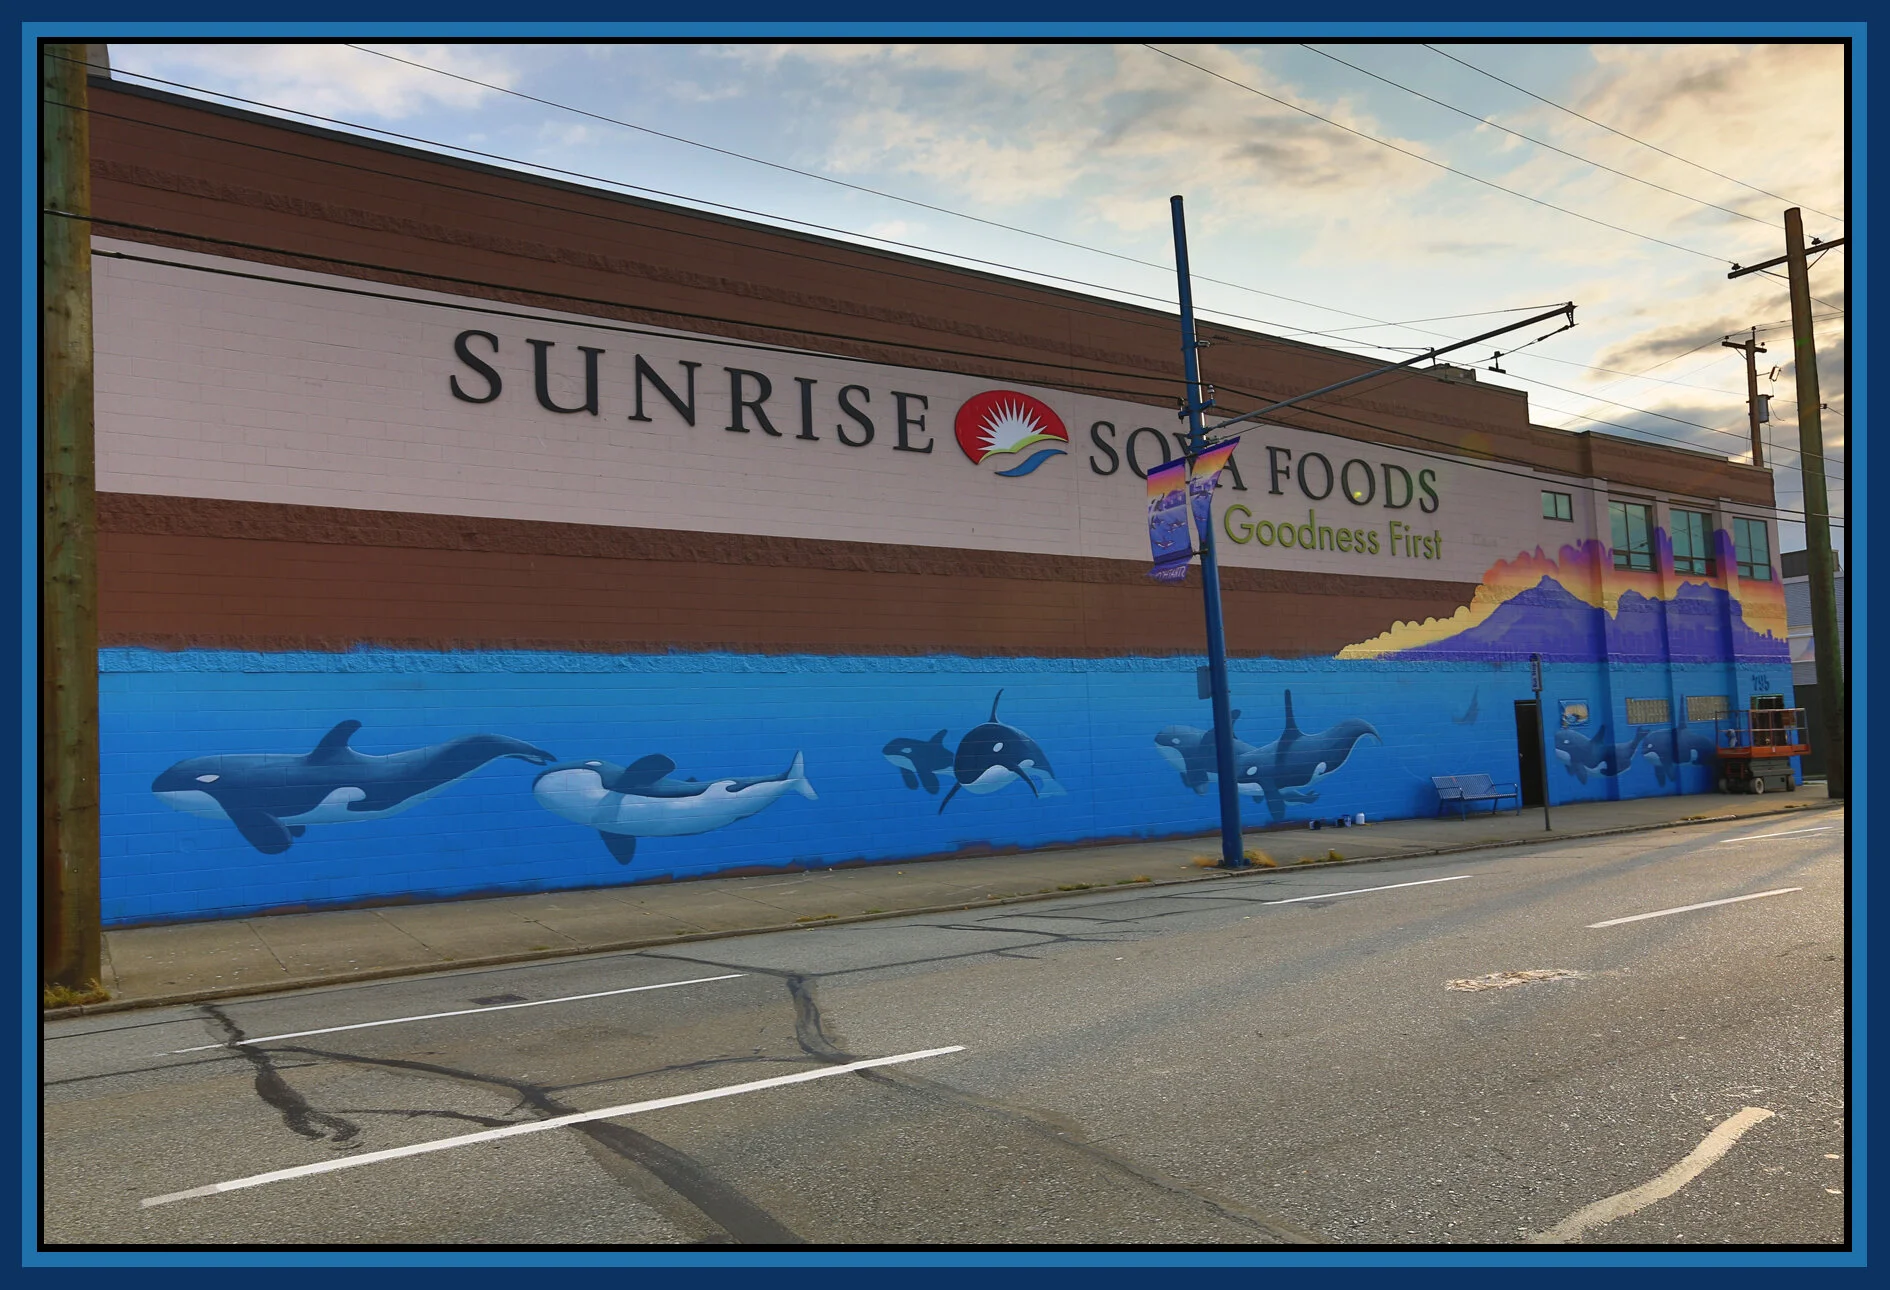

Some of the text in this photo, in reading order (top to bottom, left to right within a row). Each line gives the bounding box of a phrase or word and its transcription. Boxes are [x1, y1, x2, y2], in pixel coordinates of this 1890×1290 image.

[449, 329, 934, 453] SUNRISE
[1266, 446, 1440, 513] FOODS
[1224, 504, 1442, 560] Goodness First
[1752, 674, 1770, 691] 795
